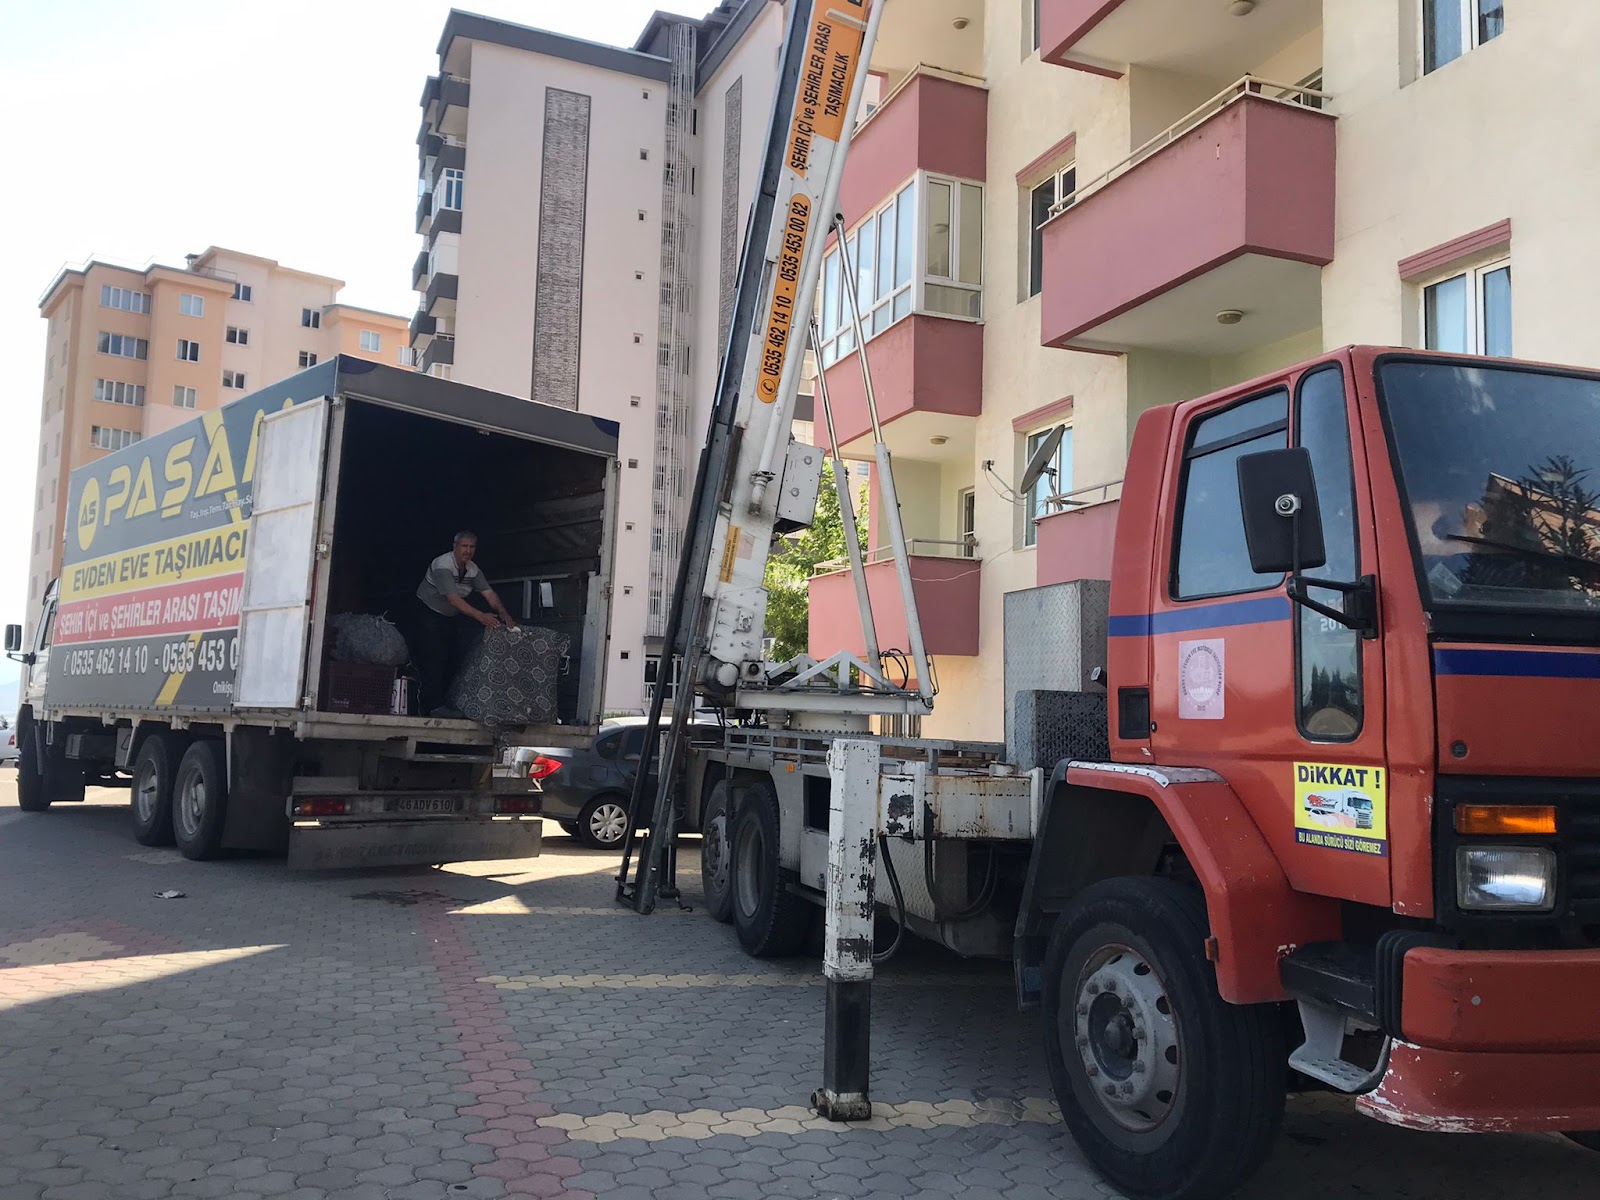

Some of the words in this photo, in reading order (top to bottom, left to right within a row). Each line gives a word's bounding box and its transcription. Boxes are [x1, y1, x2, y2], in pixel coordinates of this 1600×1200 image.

[803, 107, 815, 120] ve
[814, 21, 832, 55] ARASI
[824, 51, 849, 117] TAŞIMACILIK
[792, 201, 808, 217] 82
[789, 217, 805, 233] 00
[785, 232, 803, 254] 453
[780, 253, 799, 282] 0535
[776, 295, 792, 310] 10
[773, 310, 788, 327] 14
[769, 326, 786, 348] 462
[763, 348, 782, 376] 0535
[73, 560, 116, 592] EVDEN
[119, 553, 150, 581] EVE
[99, 612, 109, 631] ve
[162, 593, 200, 624] ARASI
[71, 649, 94, 676] 0535
[95, 647, 115, 675] 462
[118, 646, 131, 674] 14
[135, 645, 148, 674] 10
[162, 642, 195, 673] 0535
[198, 638, 225, 671] 453
[432, 800, 450, 810] 610
